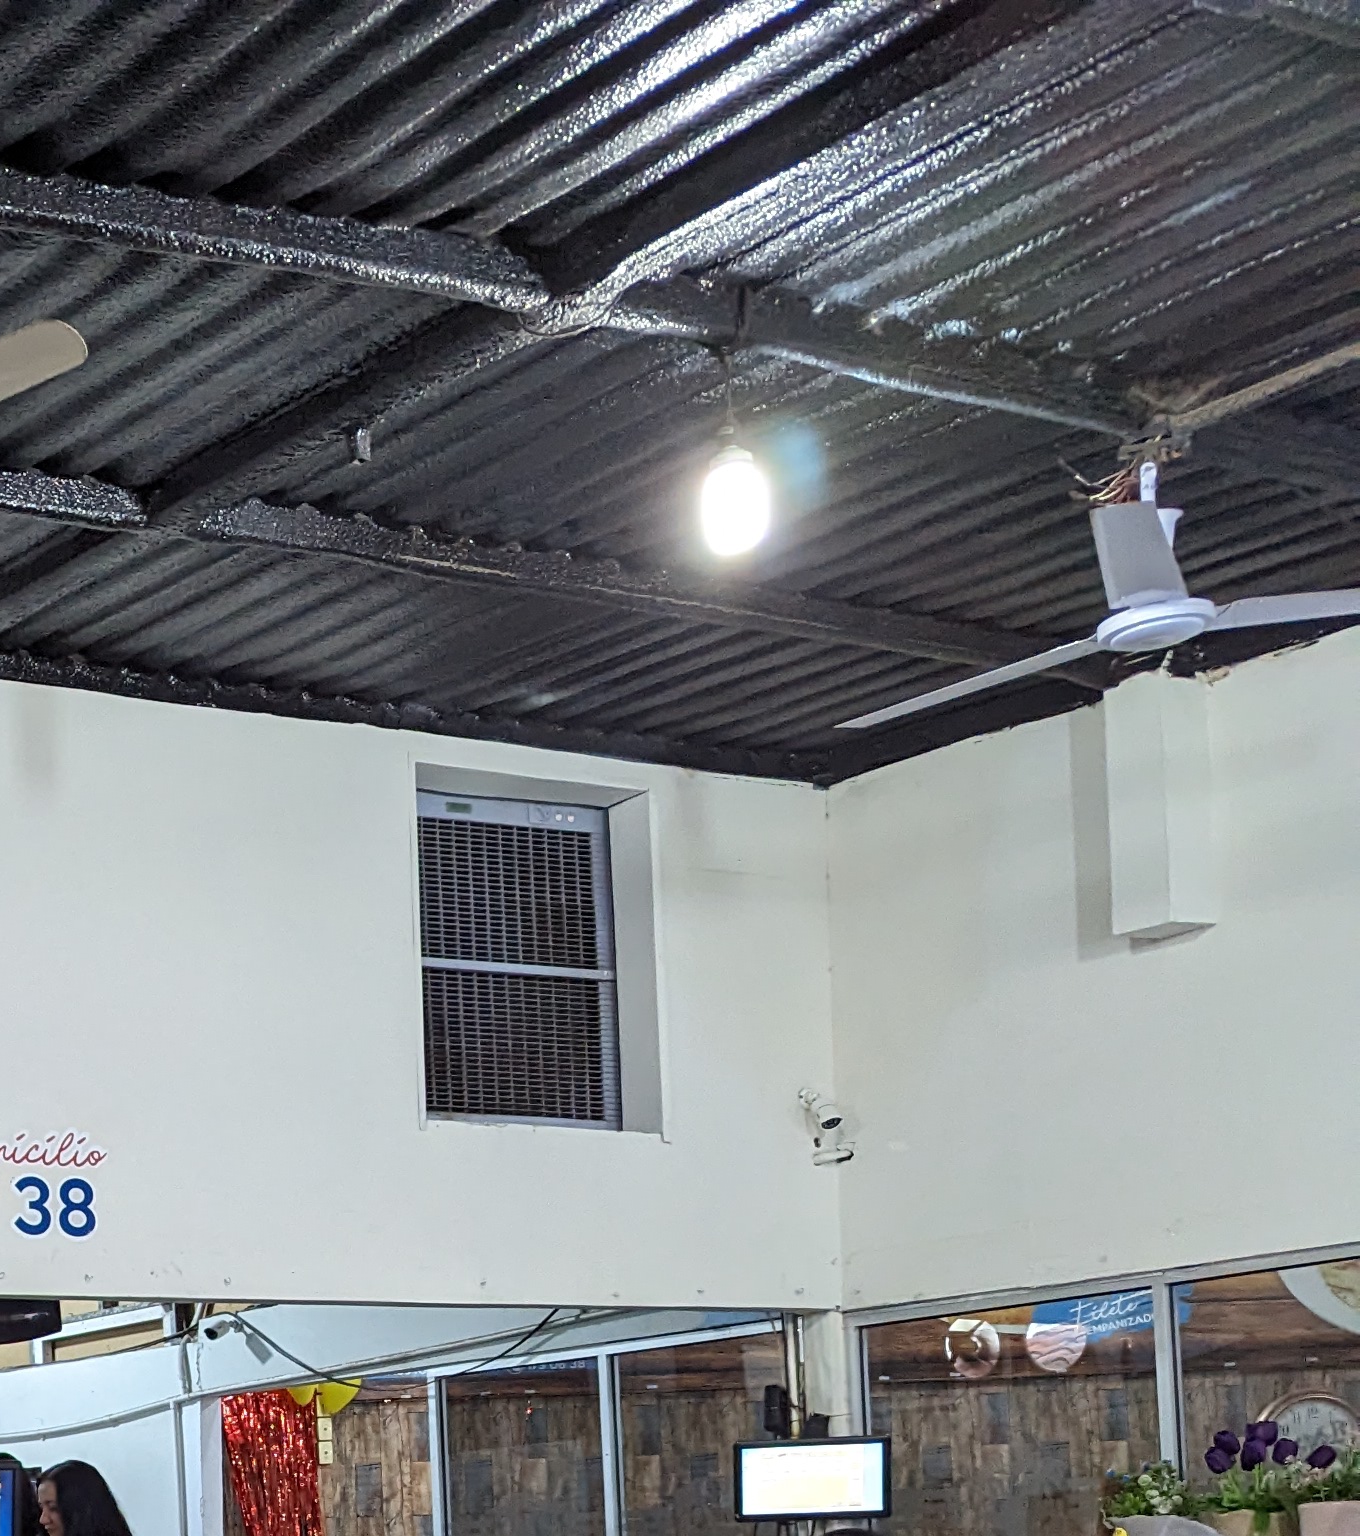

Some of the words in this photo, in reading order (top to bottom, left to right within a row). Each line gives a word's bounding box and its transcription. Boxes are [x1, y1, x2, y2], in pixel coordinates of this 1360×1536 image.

[14, 1176, 96, 1237] 38
[1069, 1289, 1153, 1335] Filete
[1087, 1313, 1154, 1335] EMPANIZAD
